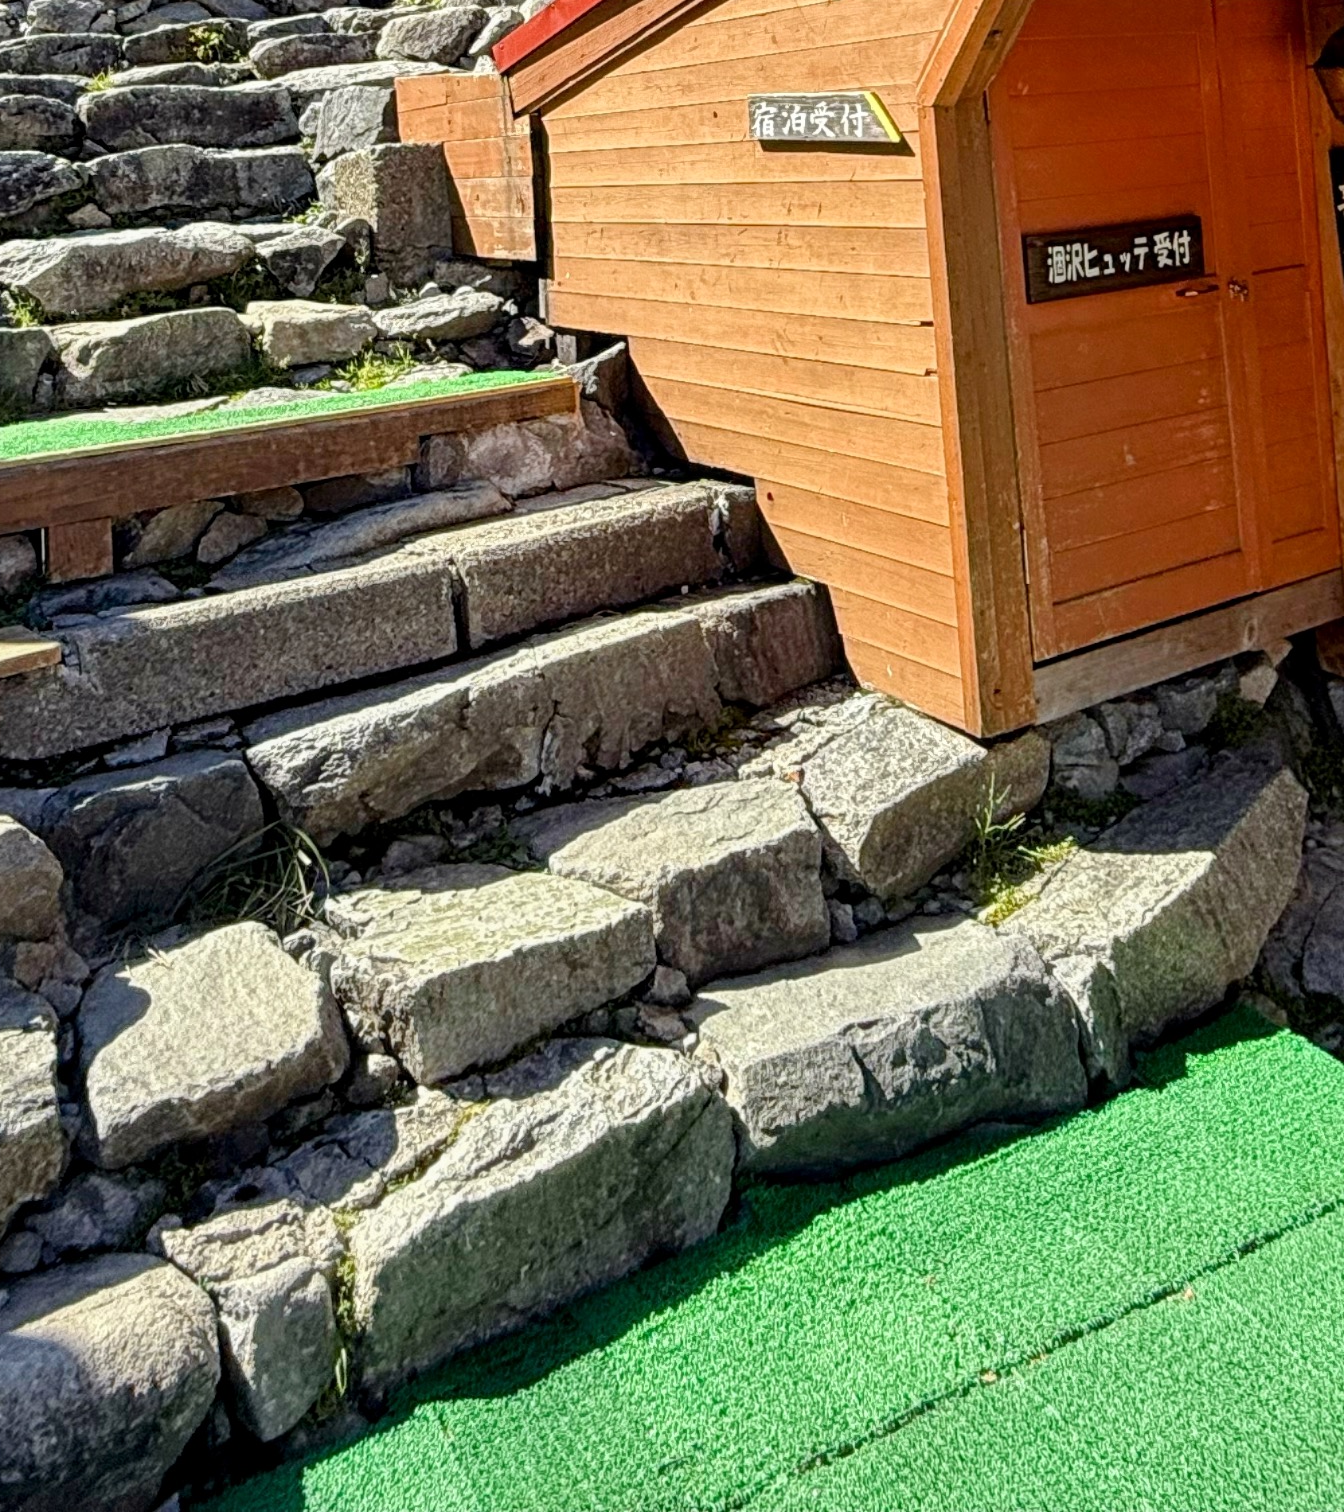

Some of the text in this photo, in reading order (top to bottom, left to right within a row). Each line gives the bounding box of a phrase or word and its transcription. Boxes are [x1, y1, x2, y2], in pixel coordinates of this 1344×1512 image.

[751, 101, 869, 139] 宿泊受付
[1047, 229, 1193, 285] 涸沢ヒュッテ受付
